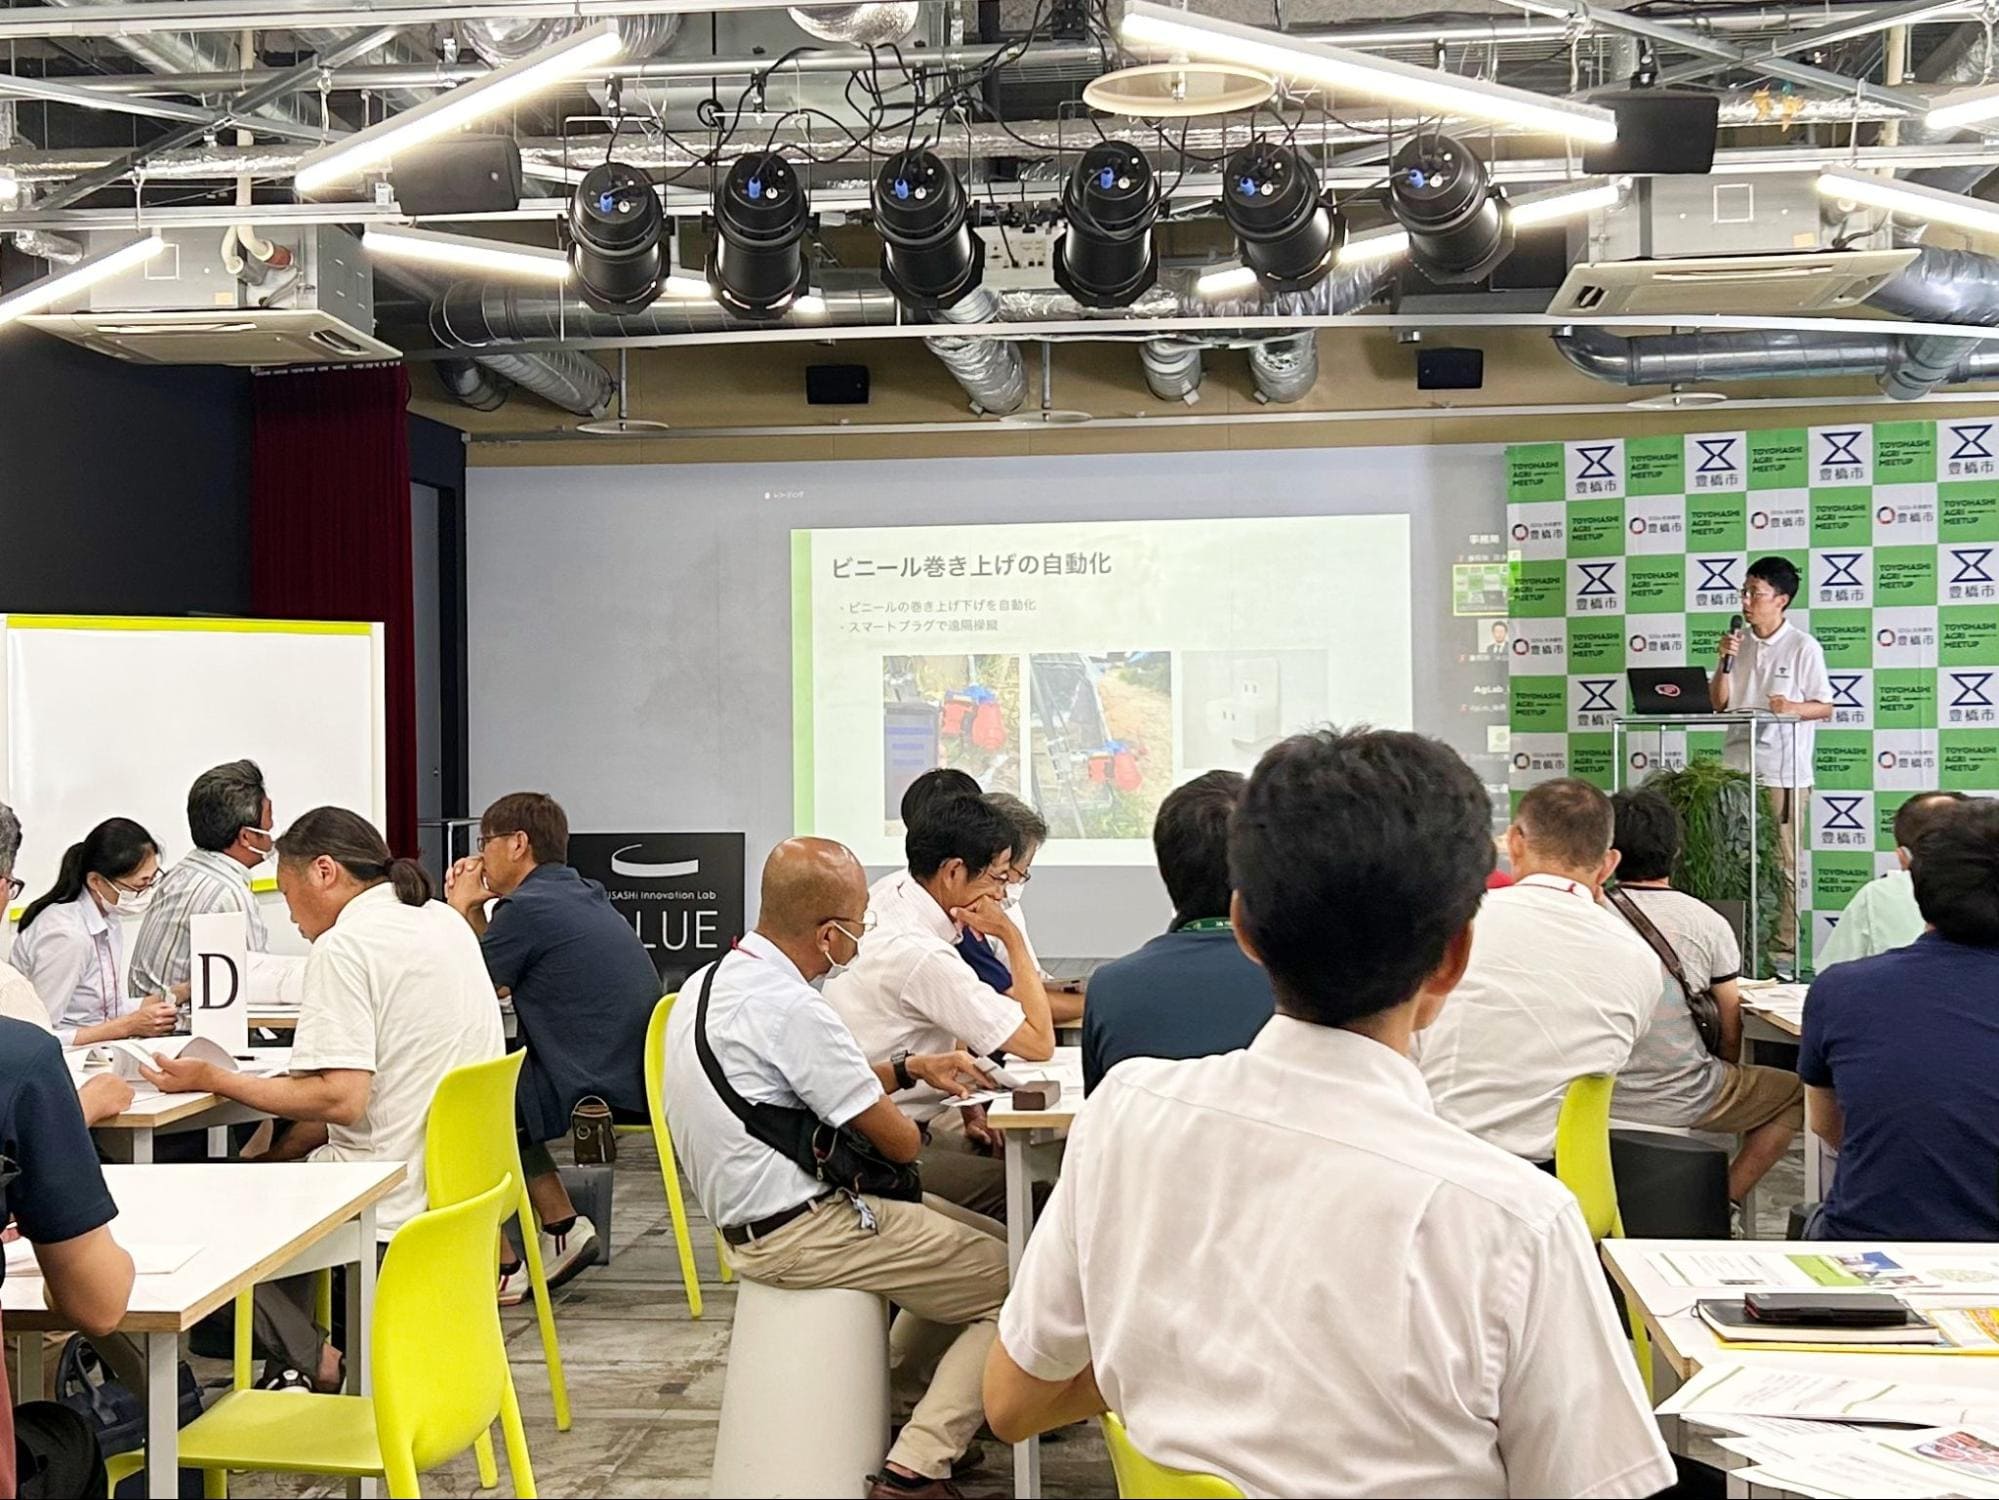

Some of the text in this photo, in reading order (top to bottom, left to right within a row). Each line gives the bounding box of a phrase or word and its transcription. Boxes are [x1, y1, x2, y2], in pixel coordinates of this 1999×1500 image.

[1879, 440, 1930, 449] TOYOHASHI
[1752, 446, 1802, 455] TOYOHASHI
[1630, 453, 1678, 462] TOYOHASHI
[1879, 458, 1913, 466] MEETUP
[1512, 462, 1559, 470] TOYOHASHI
[1752, 464, 1785, 473] MEETUP
[1949, 461, 1994, 474] 豊橋市
[1631, 471, 1663, 480] MEETUP
[1820, 467, 1863, 480] 豊橋市
[1512, 478, 1544, 487] MEETUP
[1695, 474, 1738, 487] 豊橋市
[1576, 480, 1616, 493] 豊橋市
[1944, 498, 1996, 507] TOYOHASHI
[1816, 504, 1866, 513] TOYOHASHI
[1691, 510, 1740, 519] TOYOHASHI
[1572, 516, 1619, 525] TOYOHASHI
[1944, 517, 1978, 525] MEETUP
[1815, 521, 1849, 530] MEETUP
[1691, 527, 1724, 535] MEETUP
[1572, 533, 1603, 541] MEETUP
[833, 552, 1112, 578] ビニール巻き上げの自動化
[1879, 563, 1931, 572] TOYOHASHI
[1631, 572, 1679, 580] TOYOHASHI
[1514, 577, 1560, 585] TOYOHASHI
[1879, 581, 1914, 590] MEETUP
[1631, 589, 1663, 597] MEETUP
[1820, 588, 1864, 601] 豊橋市
[1949, 585, 1995, 598] 豊橋市
[1576, 598, 1617, 610] 豊橋市
[1696, 593, 1738, 606] 豊橋市
[1944, 623, 1996, 631] TOYOHASHI
[1572, 632, 1619, 641] TOYOHASHI
[1944, 640, 1979, 649] MEETUP
[1949, 708, 1994, 721] 豊橋市
[1822, 832, 1866, 844] 豊橋市
[641, 891, 694, 900] Innovation
[697, 891, 717, 900] Lab
[636, 910, 718, 950] LUE
[198, 953, 238, 1009] D
